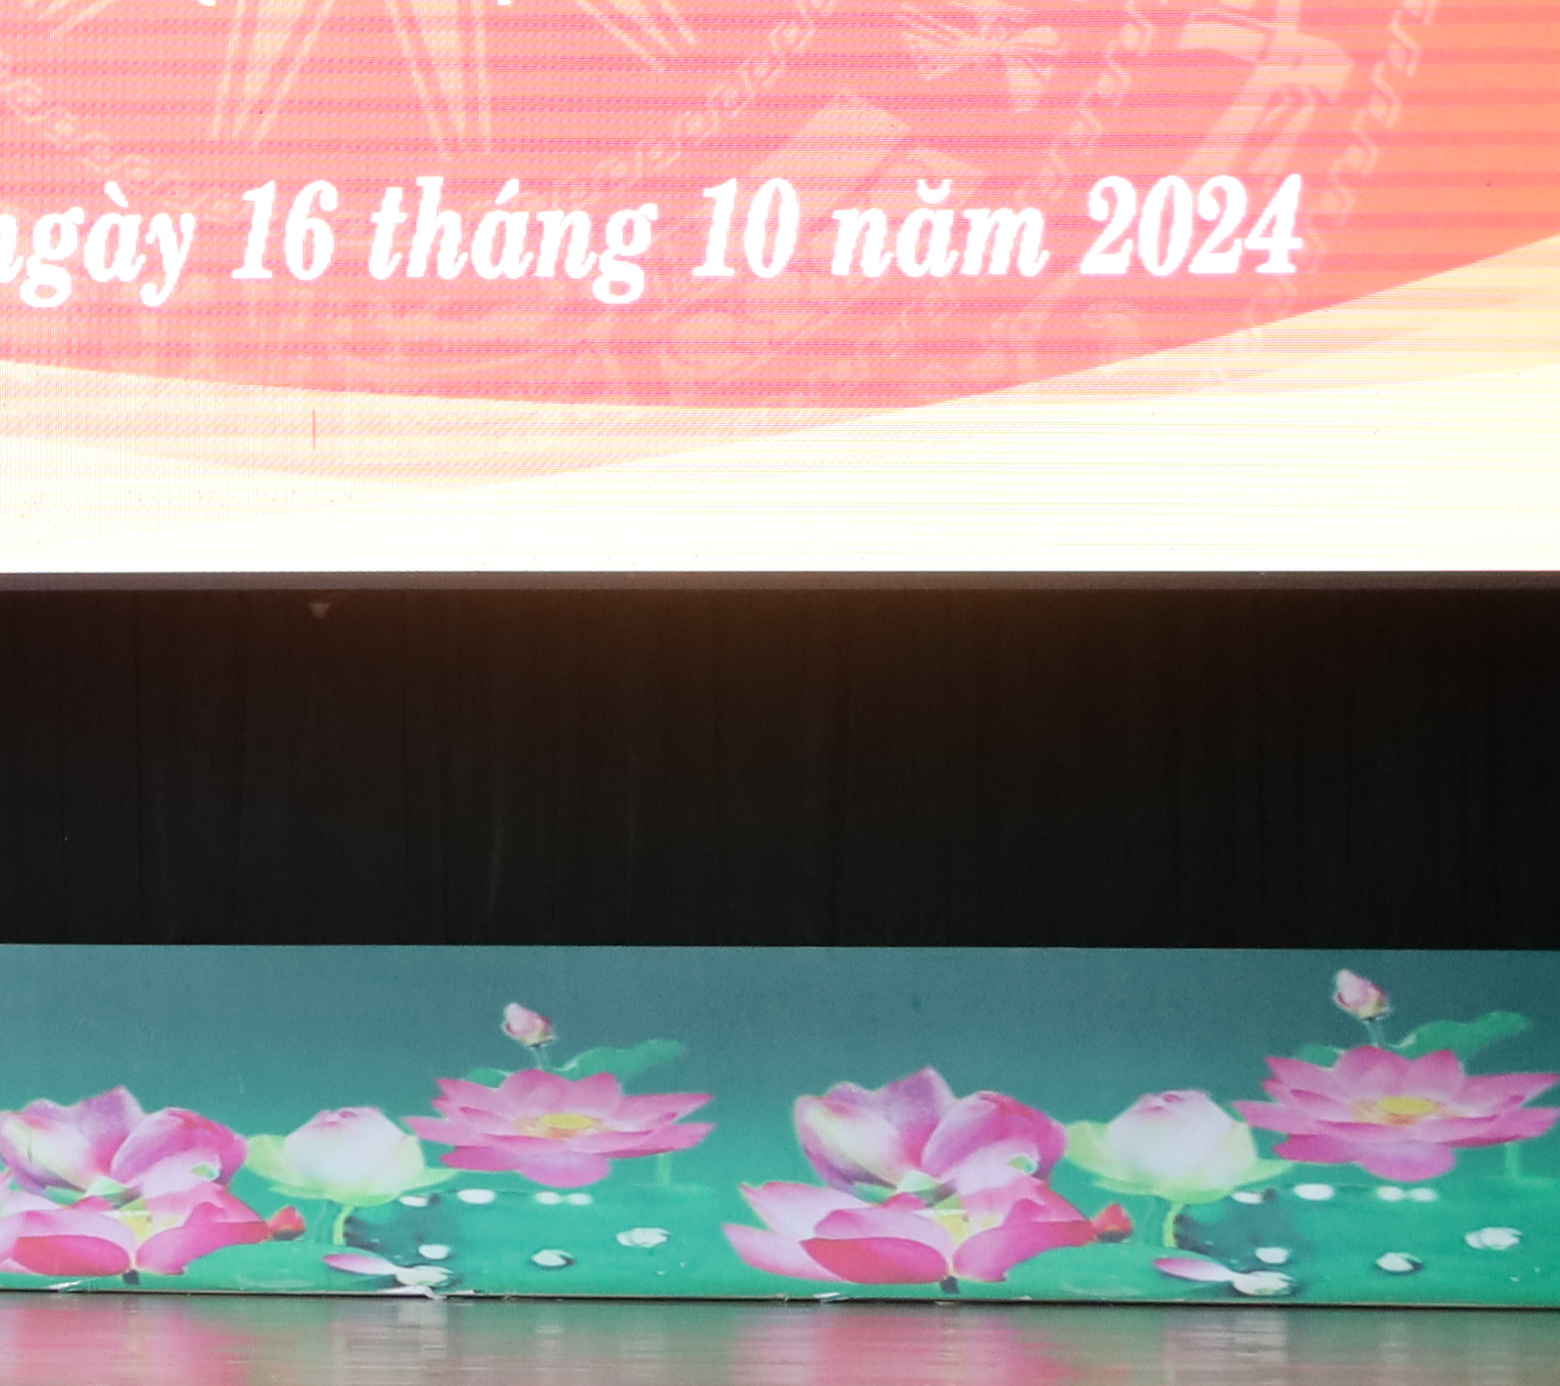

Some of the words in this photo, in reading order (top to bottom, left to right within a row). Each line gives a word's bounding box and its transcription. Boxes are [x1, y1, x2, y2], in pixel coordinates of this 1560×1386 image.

[232, 180, 338, 281] 16
[368, 176, 658, 304] tháng
[693, 178, 800, 278] 10
[832, 179, 1049, 278] năm
[1080, 174, 1302, 276] 2024
